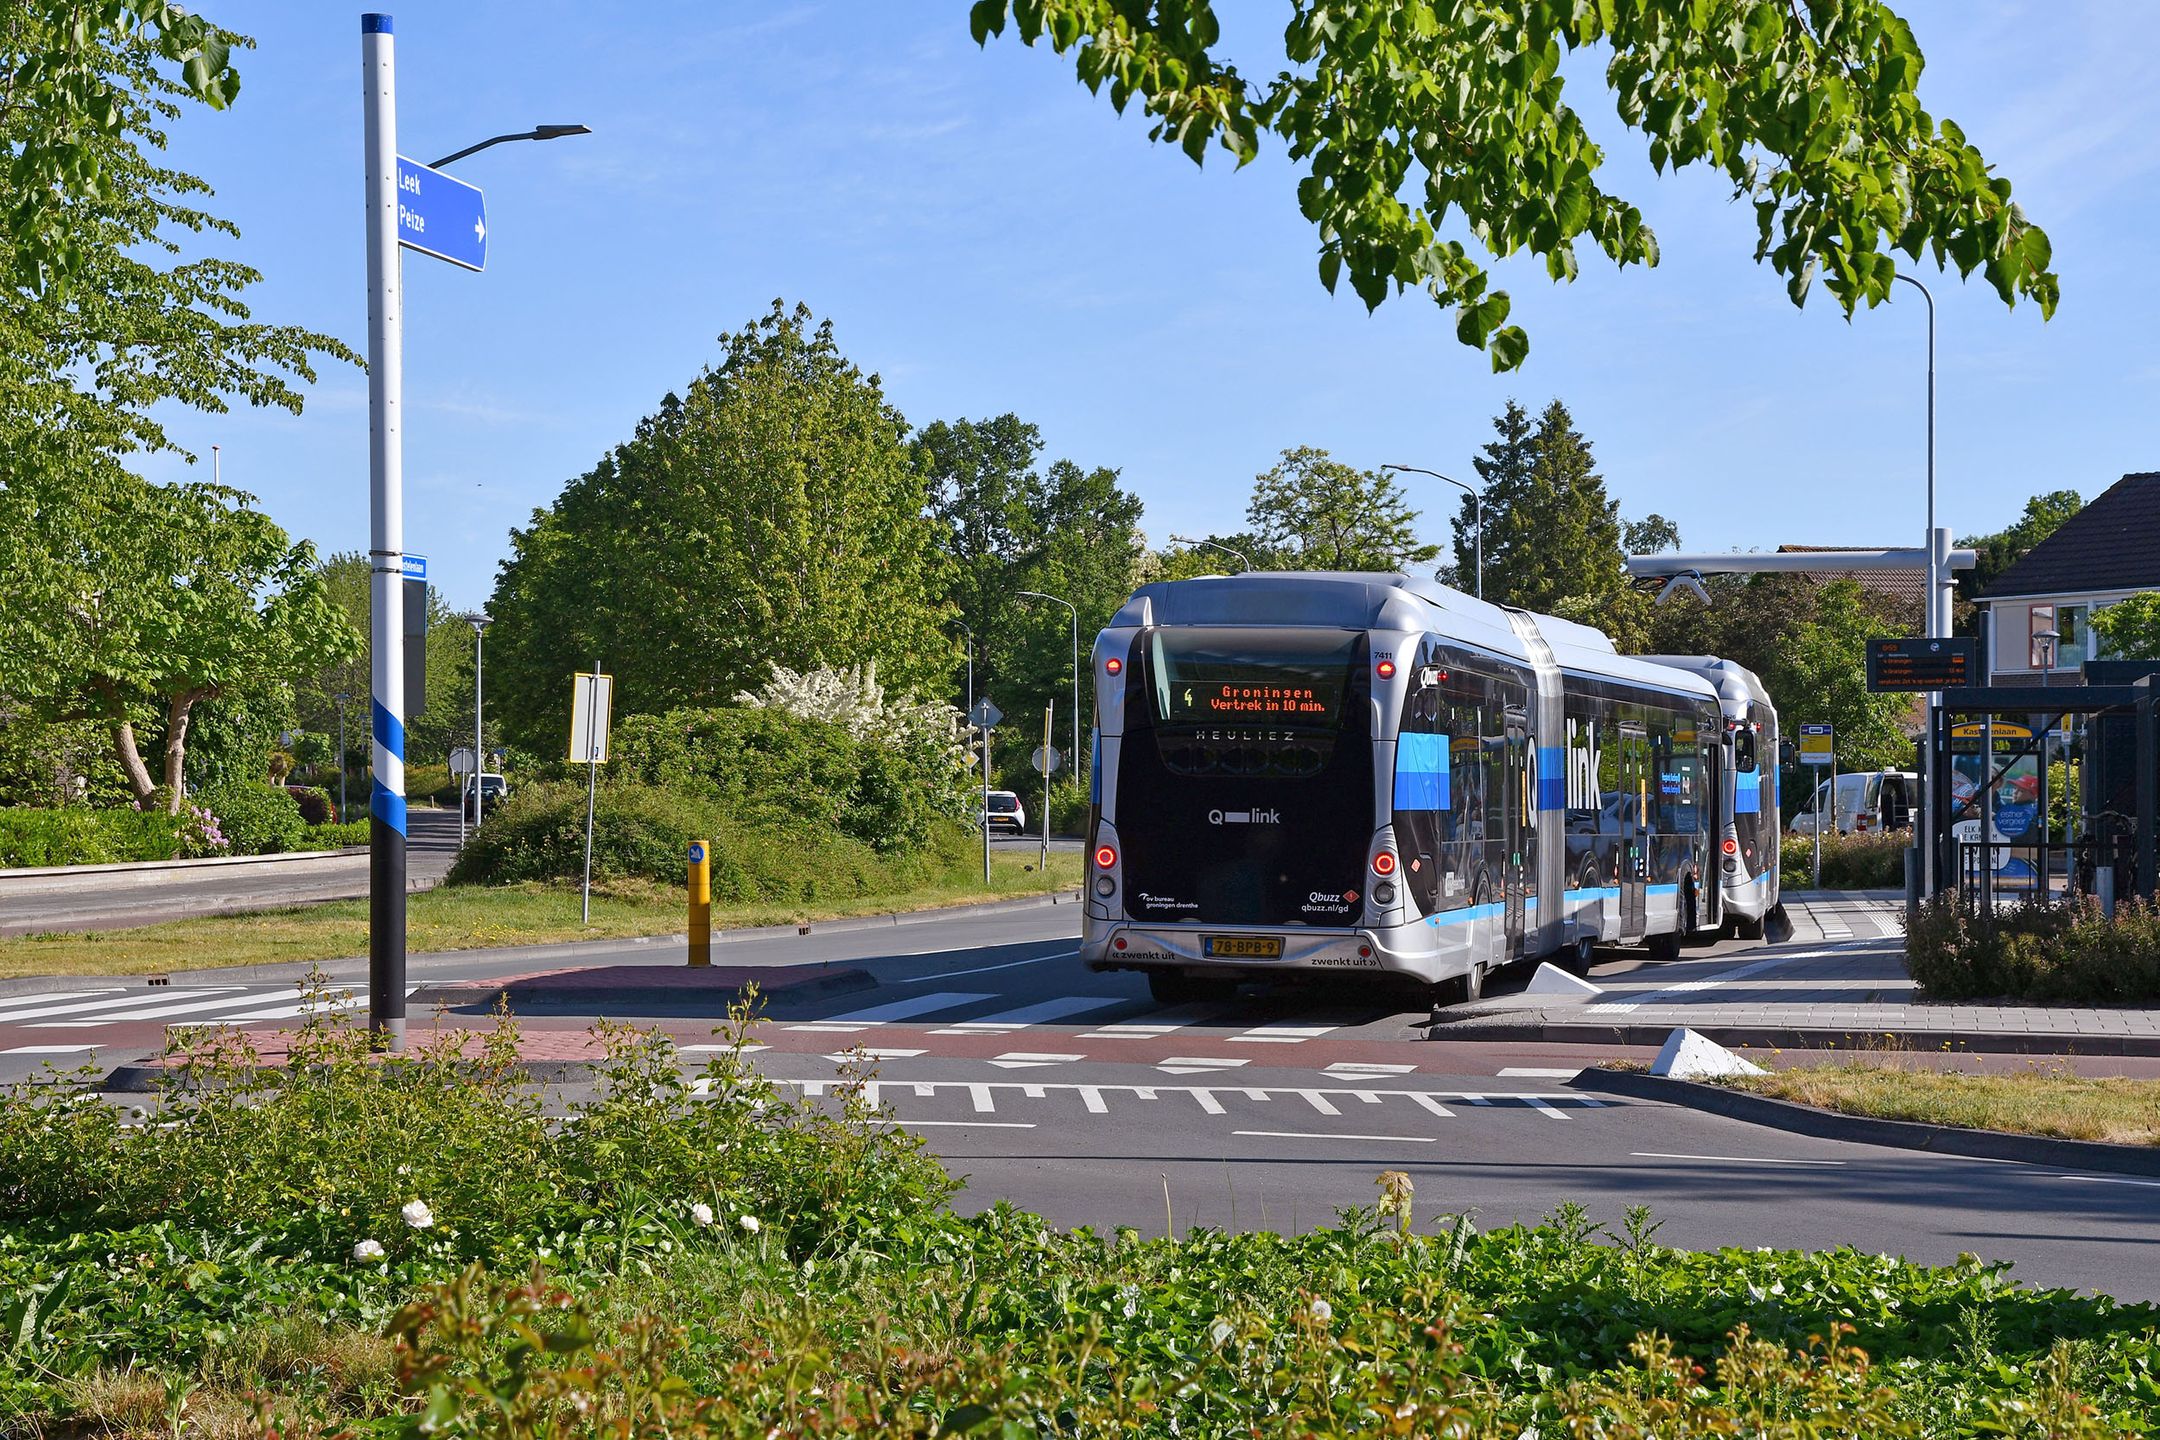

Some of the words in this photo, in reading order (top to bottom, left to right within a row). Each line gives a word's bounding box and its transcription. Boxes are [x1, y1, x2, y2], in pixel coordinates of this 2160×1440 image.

[398, 167, 421, 196] Leek
[399, 204, 425, 233] Peize
[1374, 651, 1393, 660] 7411
[1184, 688, 1193, 707] 4
[1222, 685, 1313, 699] Groningen
[1210, 699, 1262, 711] Vertrek
[1266, 699, 1279, 711] in
[1283, 700, 1296, 711] 10
[1300, 700, 1326, 712] min.
[1196, 730, 1294, 741] HEULIEZ
[1566, 717, 1602, 810] link
[1309, 891, 1340, 903] Qbuzz
[1301, 903, 1349, 913] qbuzz.nl/gd
[1216, 941, 1274, 953] 78-BPB-9
[1121, 951, 1160, 960] zwenkt
[1161, 952, 1176, 960] uit
[1311, 957, 1351, 967] zwenkt
[1352, 957, 1367, 967] uit
